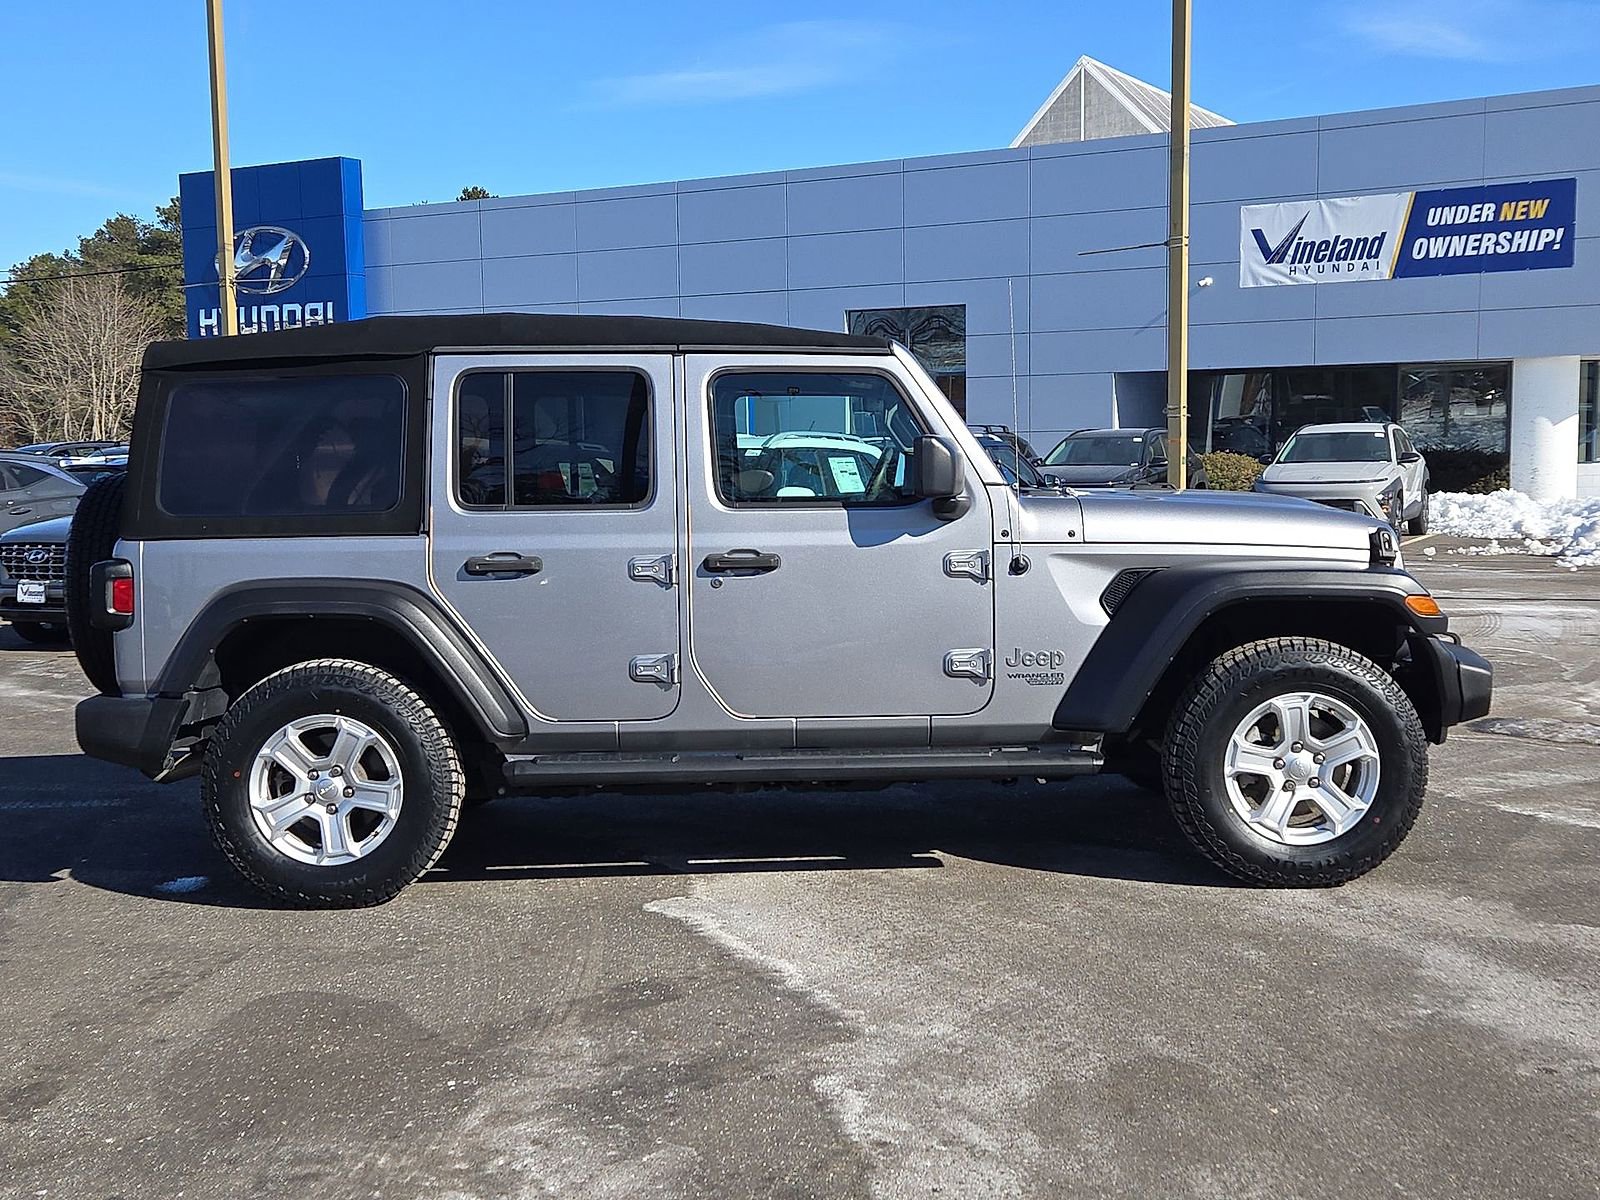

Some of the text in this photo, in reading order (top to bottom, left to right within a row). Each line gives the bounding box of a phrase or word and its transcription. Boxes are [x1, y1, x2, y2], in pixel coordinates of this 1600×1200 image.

[1427, 199, 1550, 227] UNDER NEW
[1250, 210, 1388, 265] Vineland
[1411, 227, 1566, 260] OWNERSHIP!
[1288, 261, 1382, 276] HYUNDAI
[199, 301, 334, 337] HUNDAI
[1005, 647, 1065, 670] Jeep
